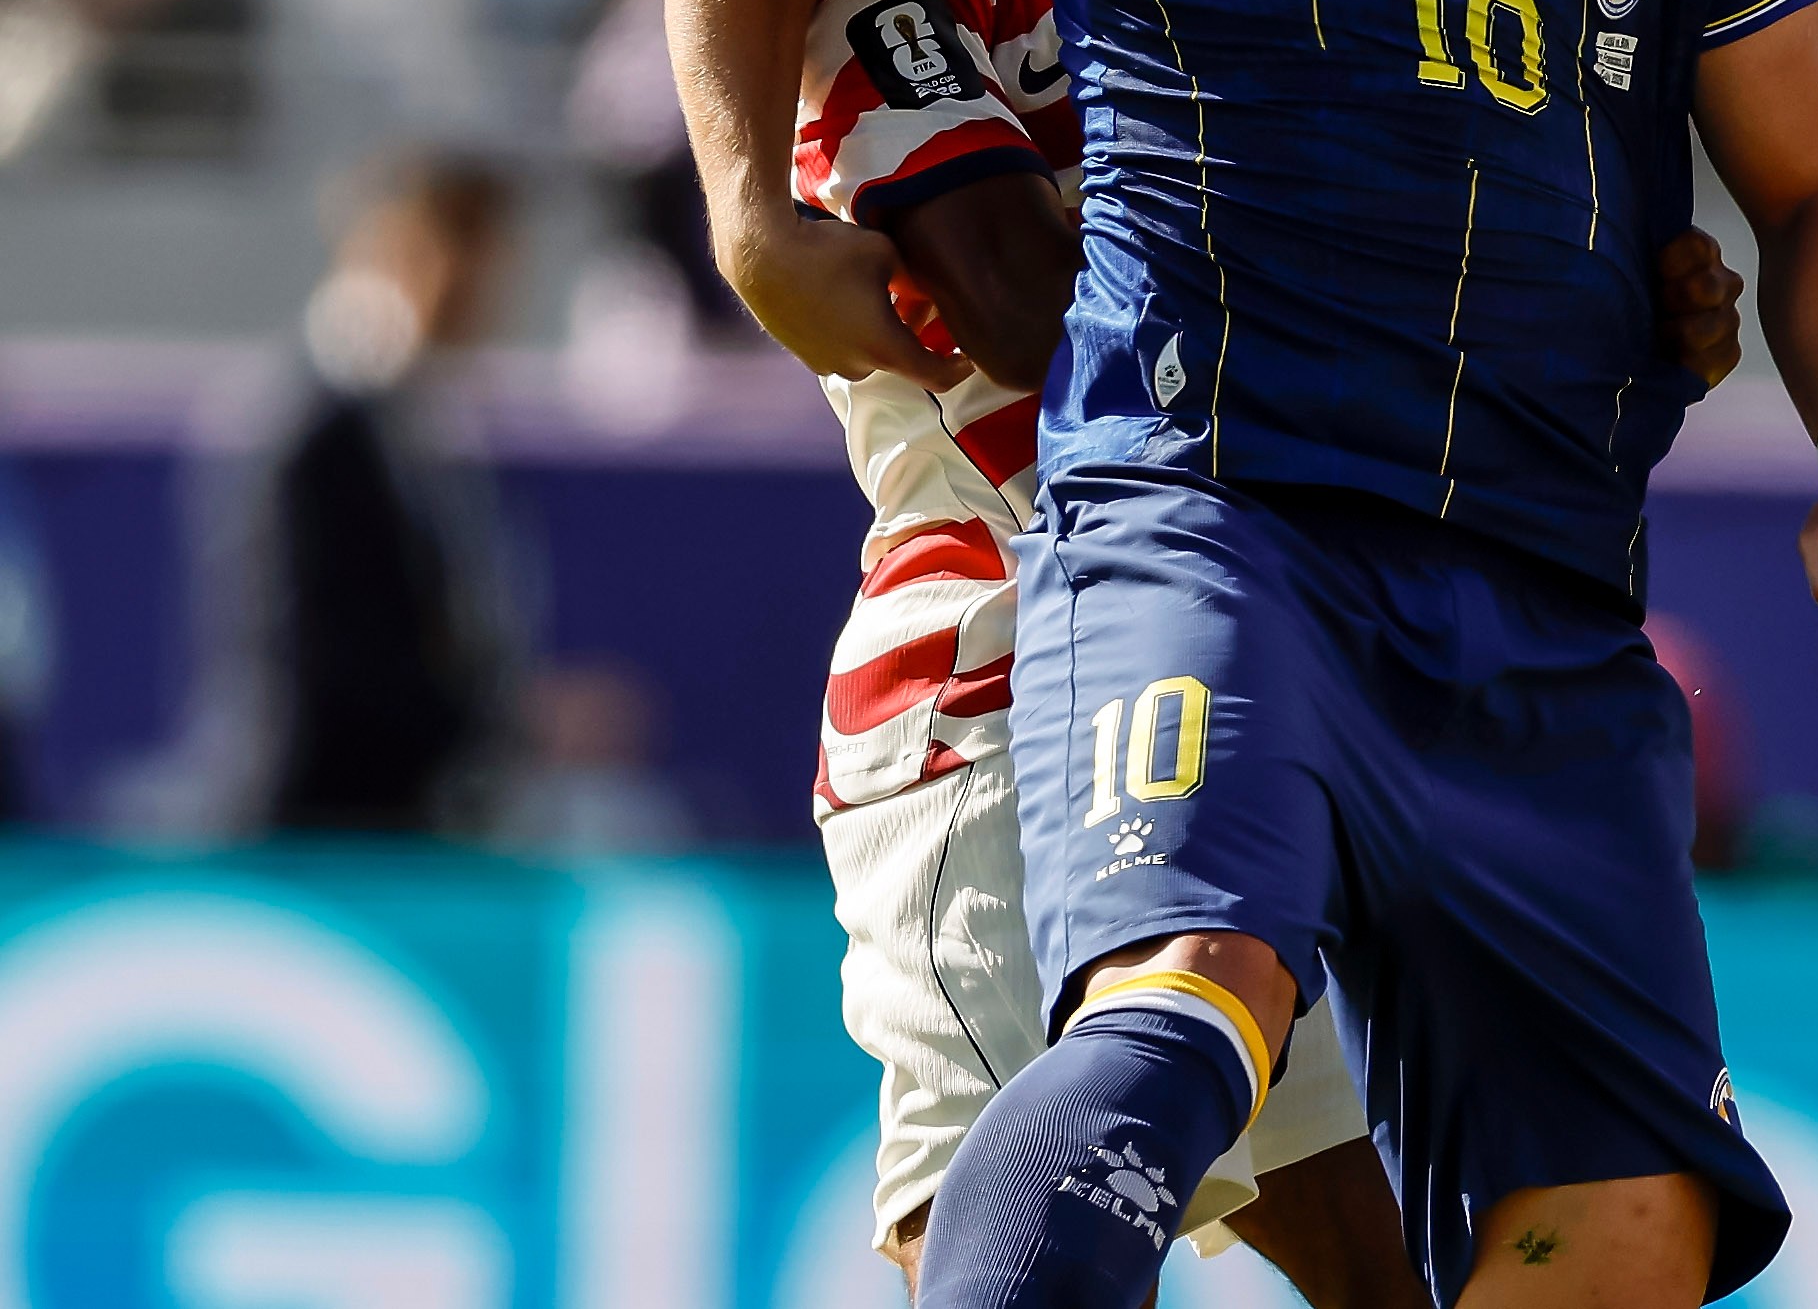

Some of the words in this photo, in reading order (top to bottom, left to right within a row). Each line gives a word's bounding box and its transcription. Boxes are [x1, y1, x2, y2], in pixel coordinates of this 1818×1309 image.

[912, 60, 937, 75] FIFA
[1082, 674, 1212, 829] 10
[1094, 852, 1167, 882] KELME
